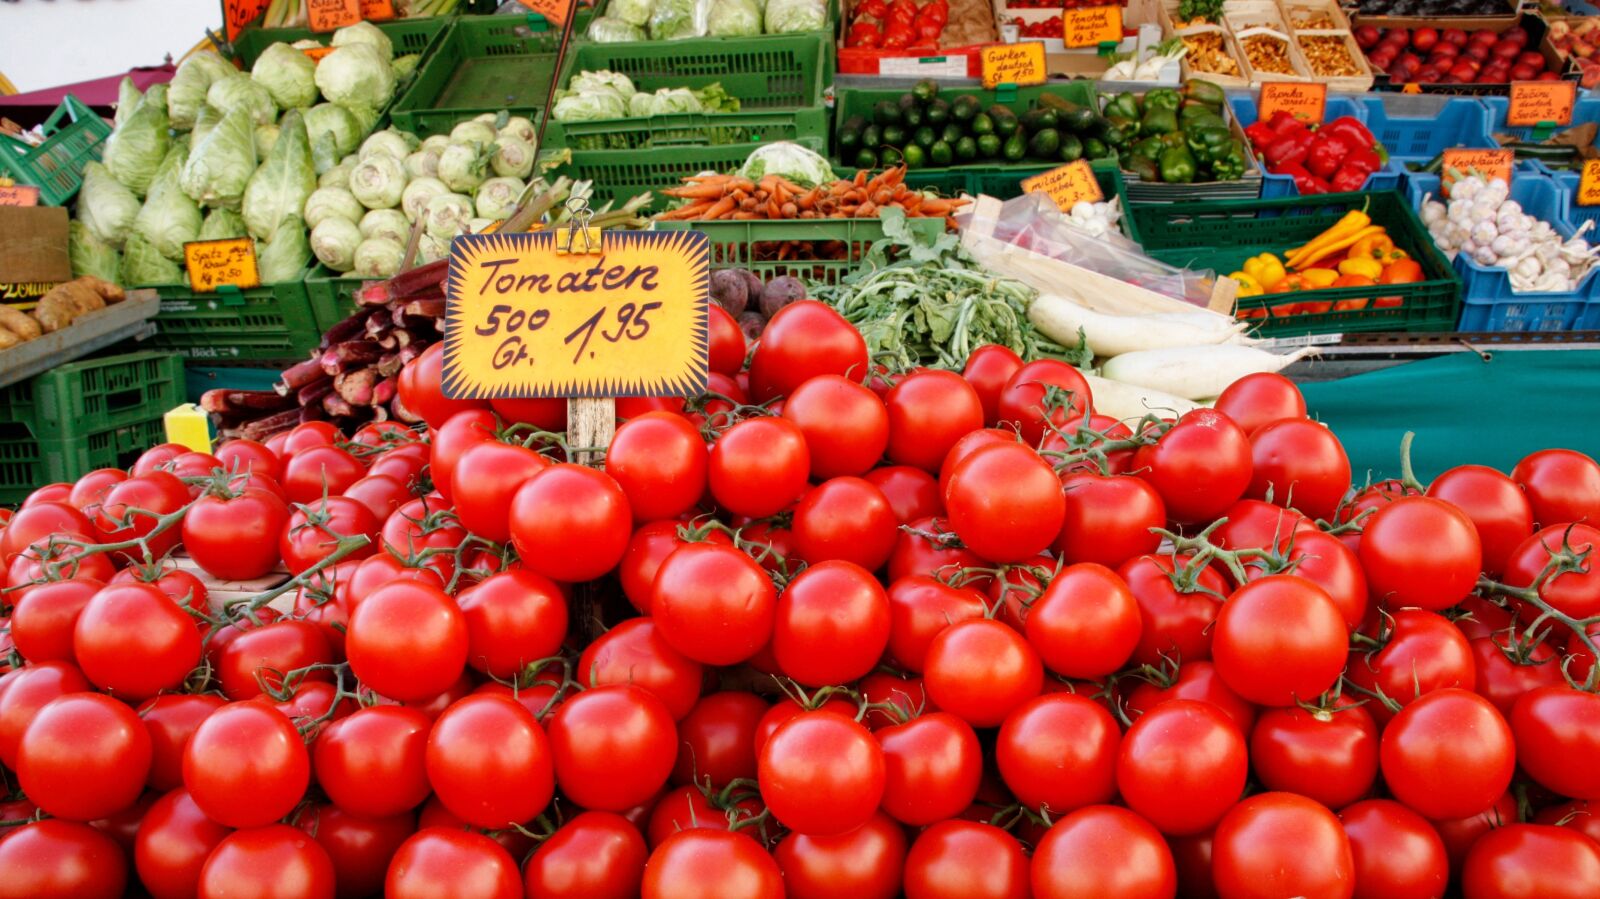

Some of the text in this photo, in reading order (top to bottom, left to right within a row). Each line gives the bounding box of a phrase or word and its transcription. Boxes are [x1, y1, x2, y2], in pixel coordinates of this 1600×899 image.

[1071, 9, 1107, 24] Fenchel
[988, 49, 1026, 63] Gurken
[996, 58, 1032, 71] deutsch
[1266, 87, 1303, 102] Paprika
[1451, 155, 1505, 168] Knoblauch
[1032, 171, 1067, 193] milder
[192, 247, 221, 264] Spitz
[480, 256, 659, 296] Tomaten
[475, 301, 663, 364] 500 1.95
